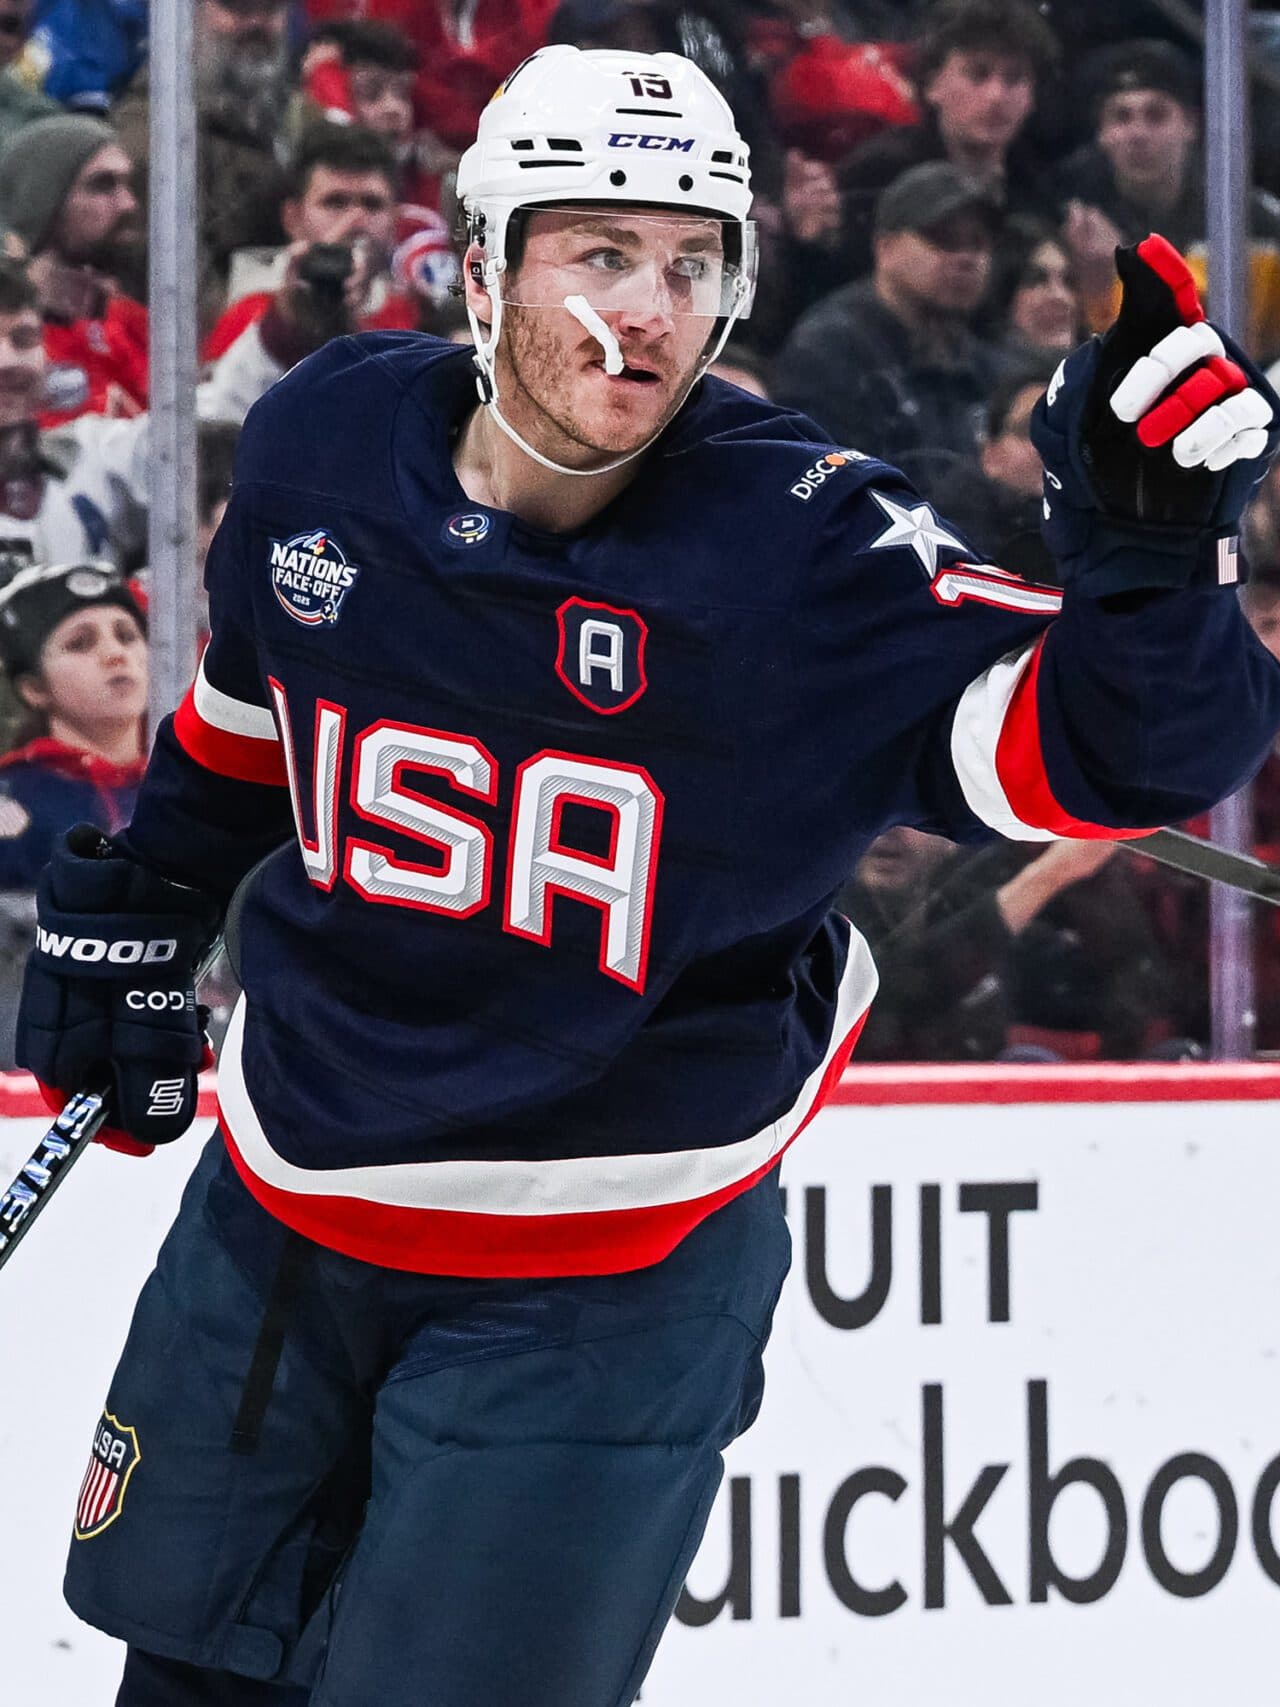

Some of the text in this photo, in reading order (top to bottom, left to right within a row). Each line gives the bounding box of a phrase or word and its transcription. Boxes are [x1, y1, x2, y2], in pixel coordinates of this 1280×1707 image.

[607, 133, 695, 152] CCM
[270, 542, 358, 587] NATIONS
[579, 619, 624, 692] A
[267, 674, 666, 996] USA
[36, 925, 178, 964] WOOD
[779, 1179, 1039, 1330] UIT
[94, 1422, 127, 1469] USA
